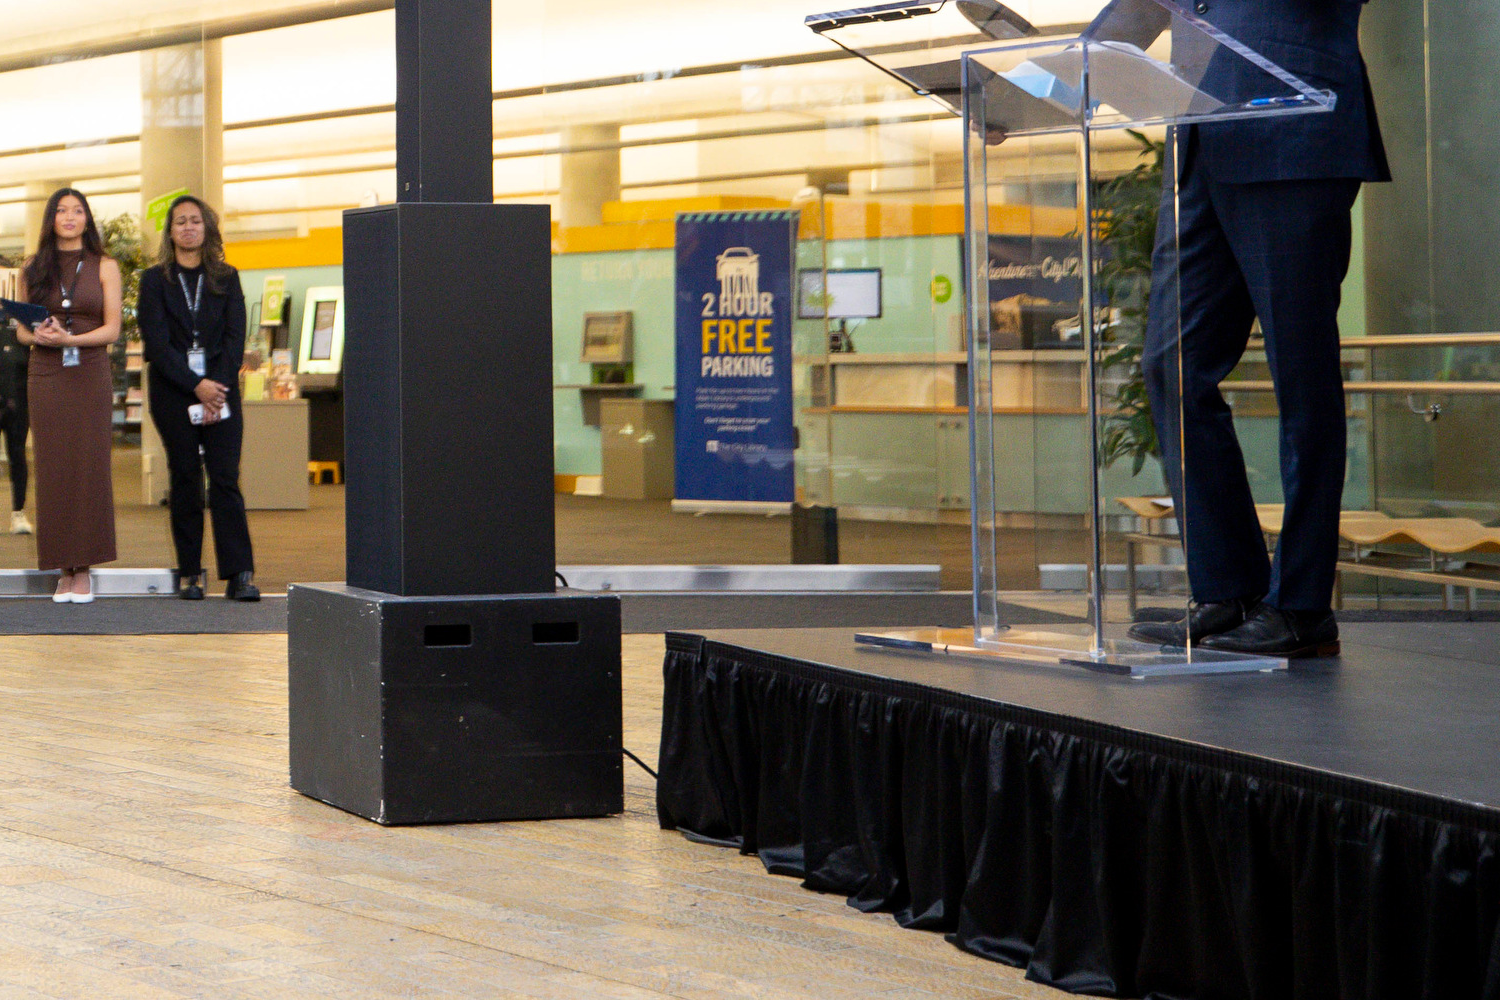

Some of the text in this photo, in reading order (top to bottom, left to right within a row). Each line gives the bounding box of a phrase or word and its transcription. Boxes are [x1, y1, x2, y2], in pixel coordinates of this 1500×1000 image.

[701, 291, 774, 317] 2 HOUR
[701, 319, 774, 355] FREE
[701, 355, 774, 378] PARKING
